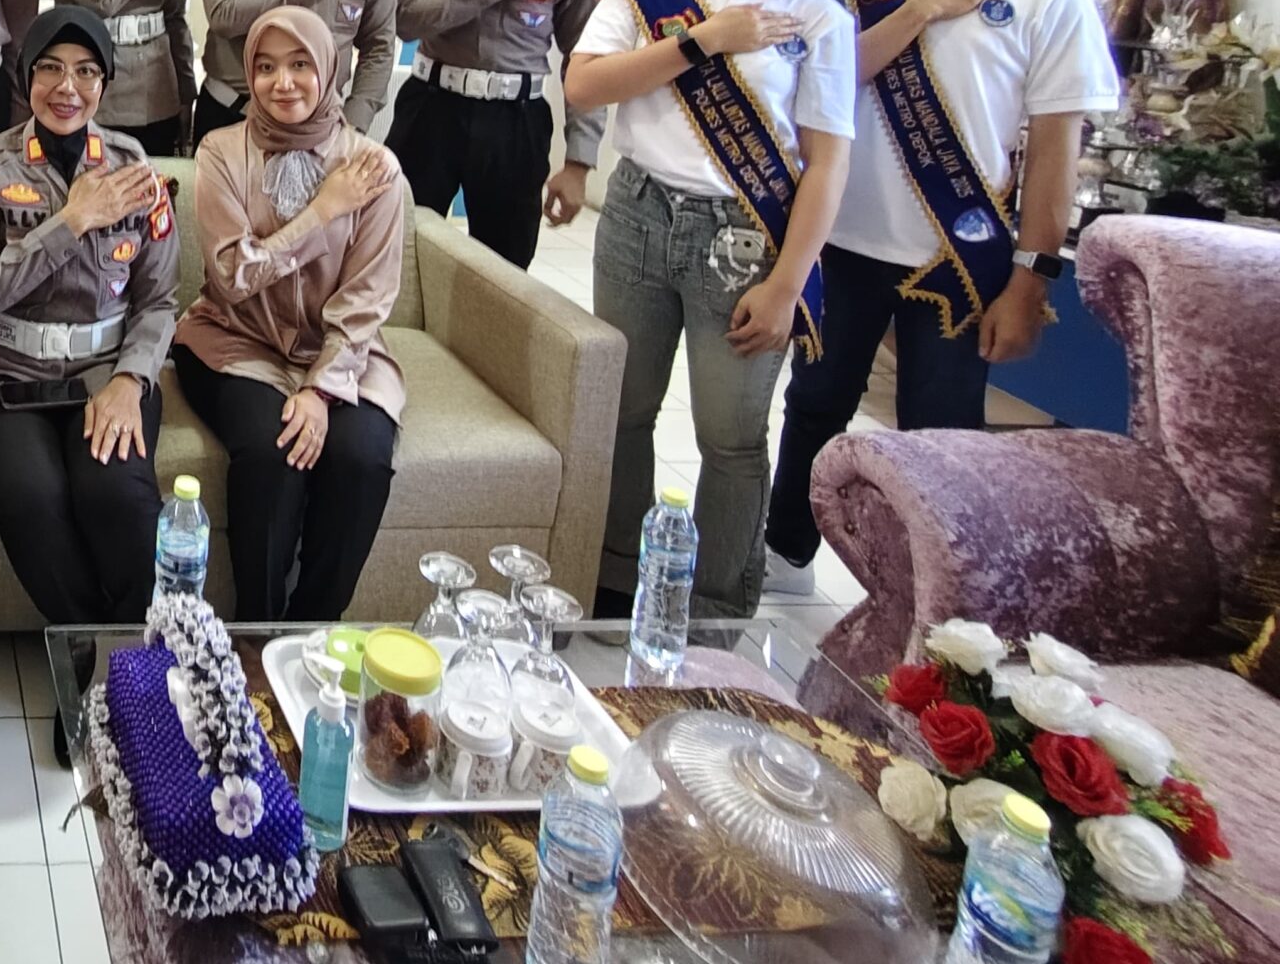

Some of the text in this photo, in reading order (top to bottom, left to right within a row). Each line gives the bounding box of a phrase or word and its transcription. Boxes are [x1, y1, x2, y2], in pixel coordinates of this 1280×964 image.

[691, 86, 770, 203] POLRES METRO DEPOK
[706, 75, 730, 101] LALU
[721, 98, 751, 134] LINTAS
[740, 130, 778, 179] MANDALA
[891, 90, 917, 129] METRO
[909, 130, 936, 170] DEPOK
[915, 96, 949, 147] MANDALA
[936, 145, 962, 176] JAYA
[950, 174, 975, 199] 2025
